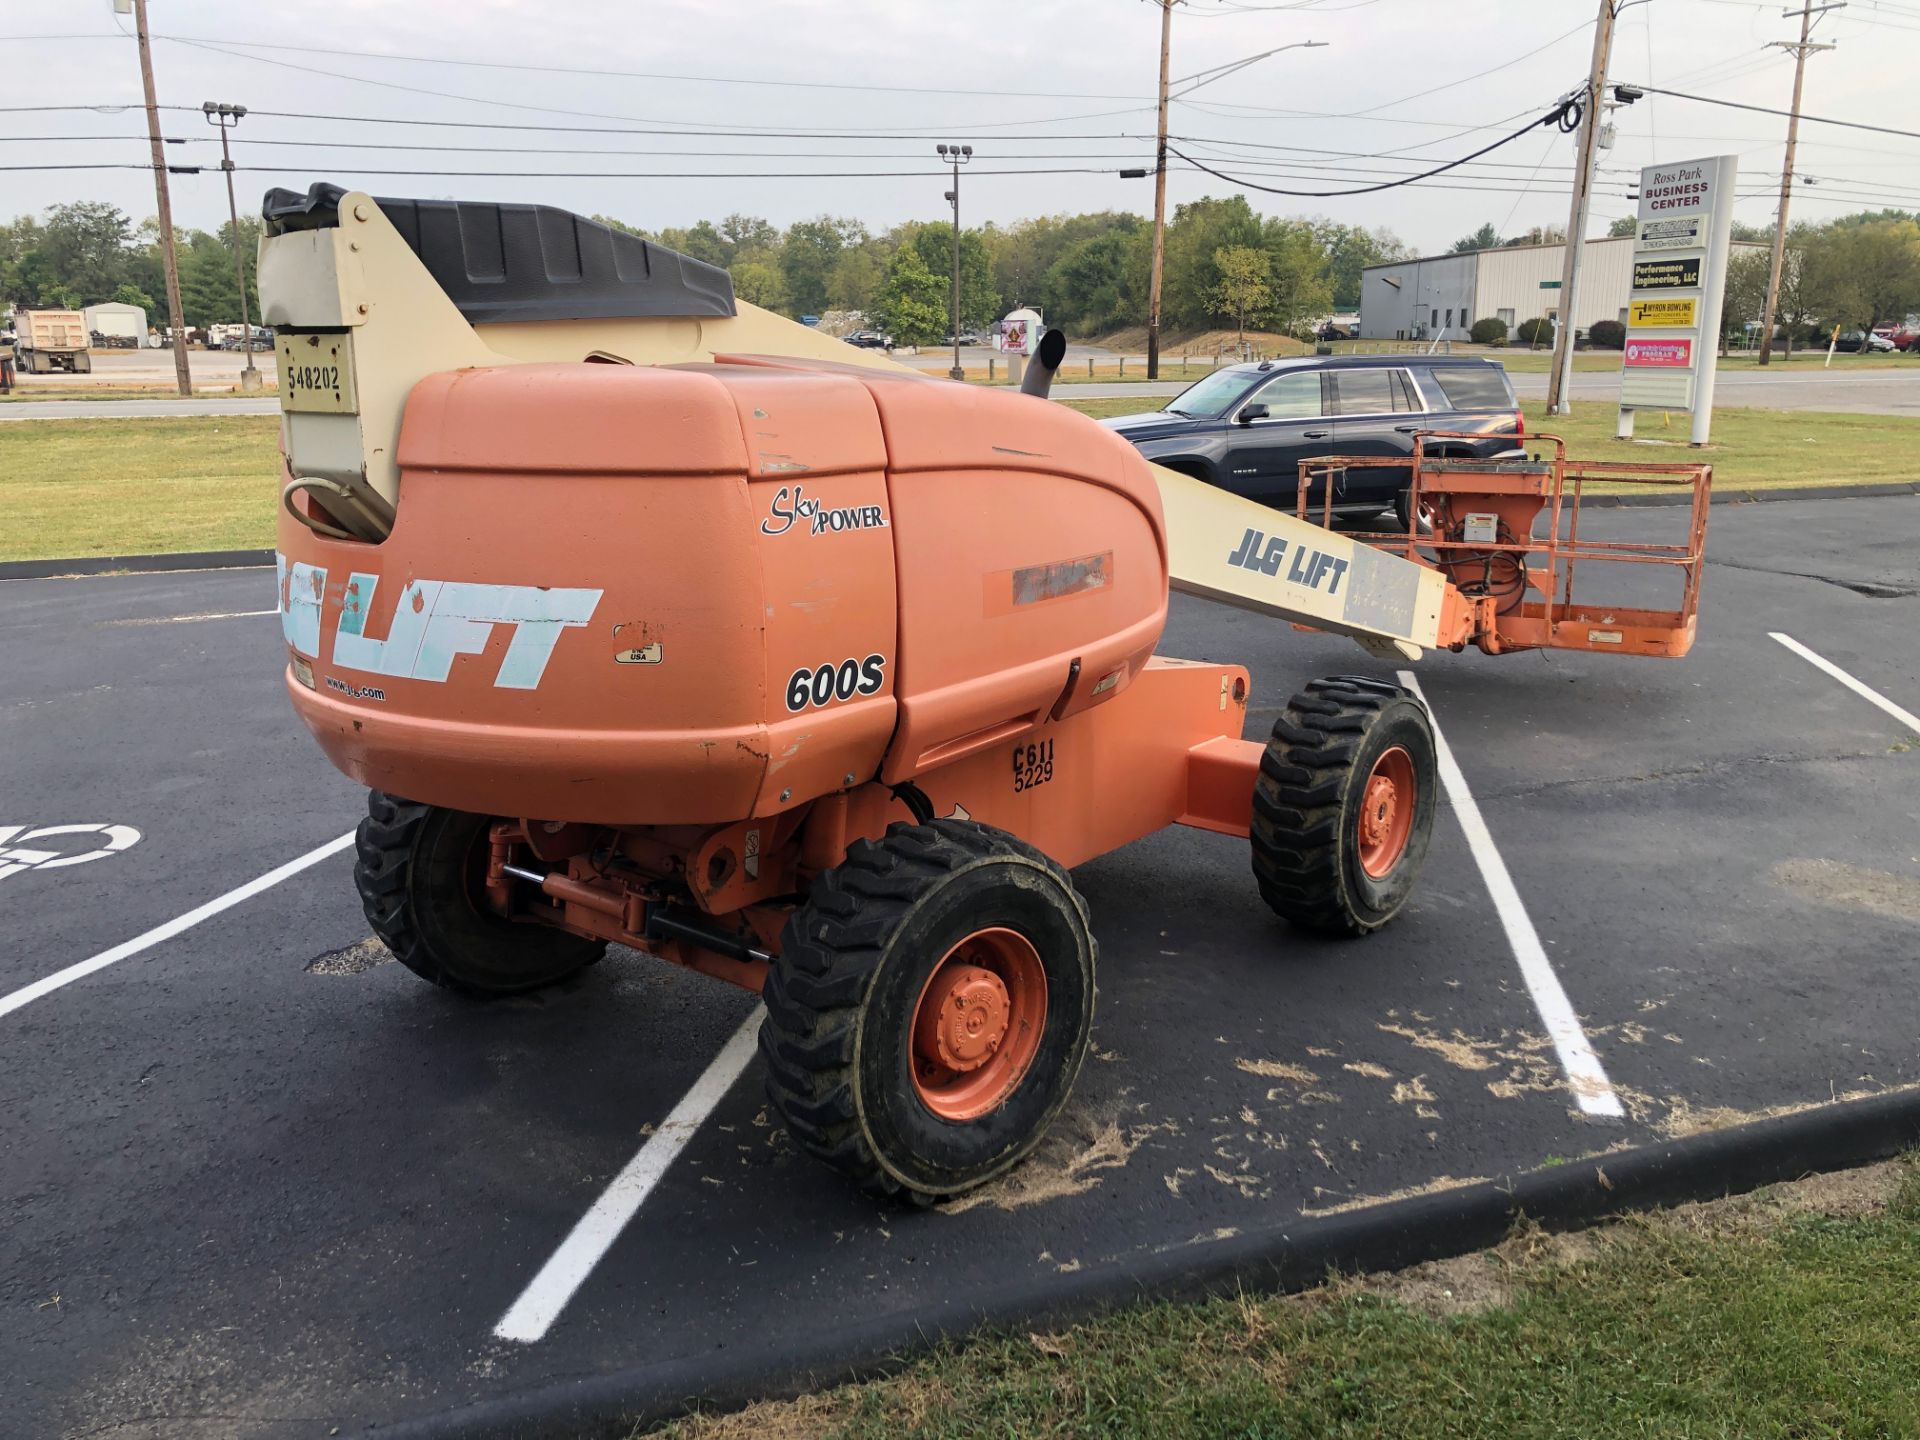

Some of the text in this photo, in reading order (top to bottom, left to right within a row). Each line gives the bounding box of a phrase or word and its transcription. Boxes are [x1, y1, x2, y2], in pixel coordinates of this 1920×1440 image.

[1653, 167, 1702, 185] Ross Park
[1645, 182, 1708, 199] BUSINESS
[1651, 196, 1700, 210] CENTER
[1635, 264, 1684, 275] Performance
[1634, 272, 1697, 287] Engineering, LLC
[1667, 302, 1692, 312] BOWLING
[287, 365, 340, 390] 548202
[1228, 527, 1349, 595] JLG LIFT
[333, 571, 605, 690] LIFT
[630, 653, 647, 661] USA
[785, 652, 887, 713] 600S
[1013, 737, 1054, 773] C611
[1014, 760, 1053, 793] 5229
